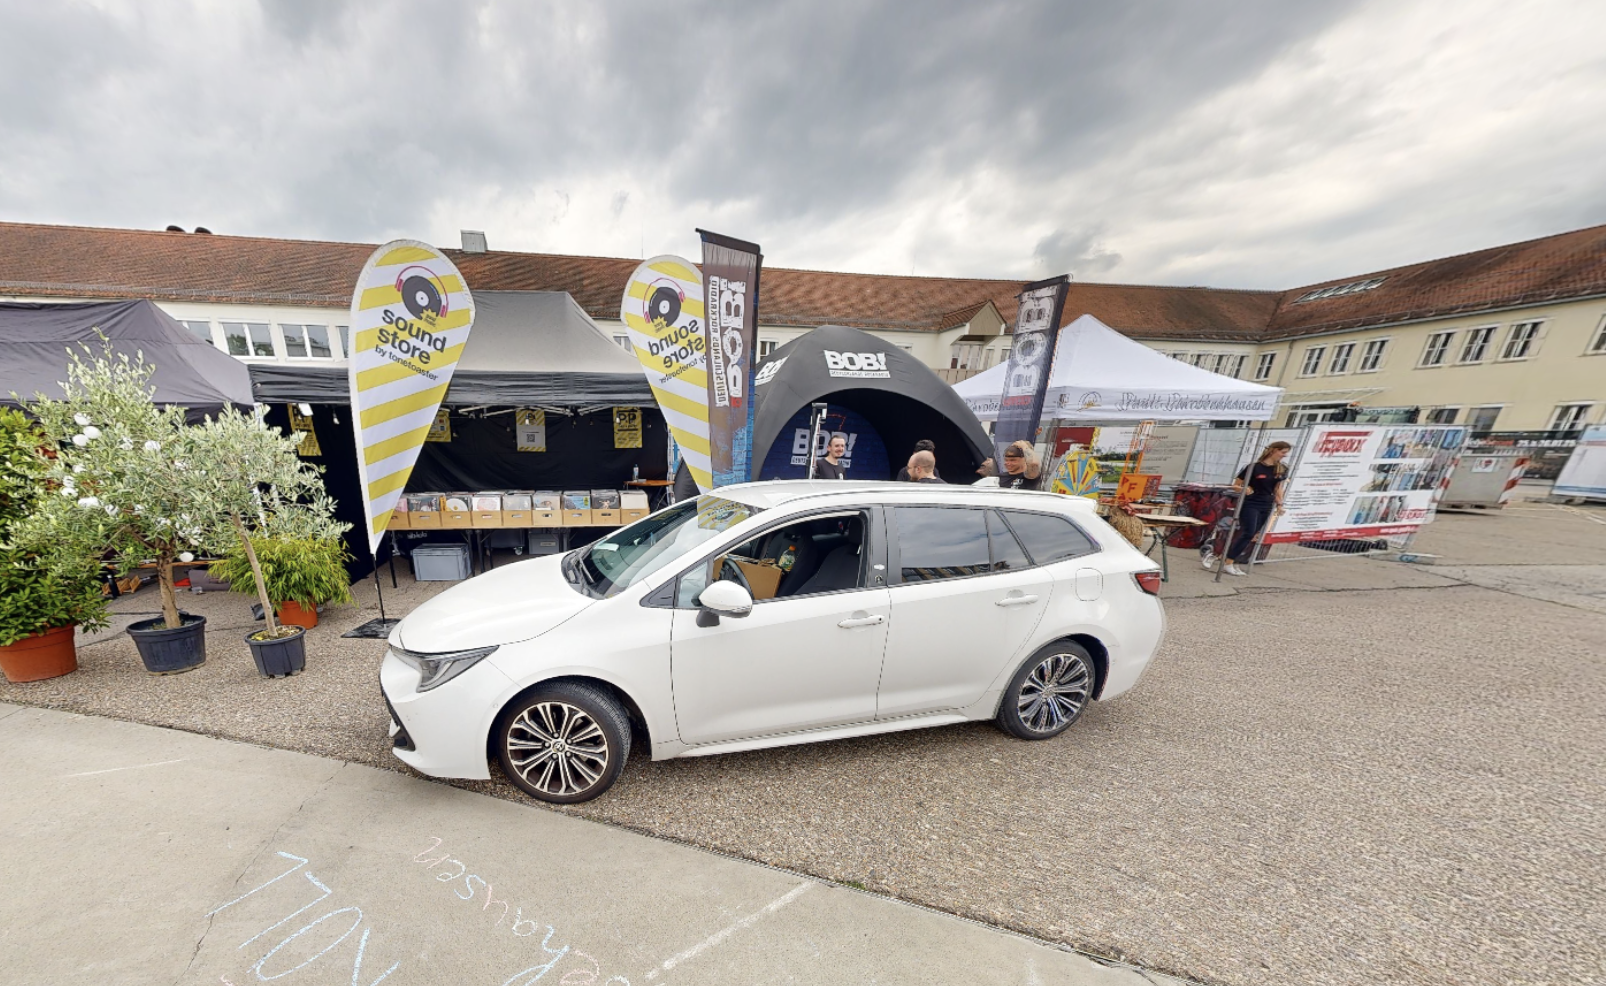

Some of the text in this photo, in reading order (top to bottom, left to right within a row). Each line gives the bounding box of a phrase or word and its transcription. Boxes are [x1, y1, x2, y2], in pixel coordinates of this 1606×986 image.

[377, 328, 431, 364] store
[382, 309, 447, 353] sound
[374, 344, 439, 381] by tonetoaster
[825, 350, 887, 370] BOB!
[413, 836, 630, 986] ehausen
